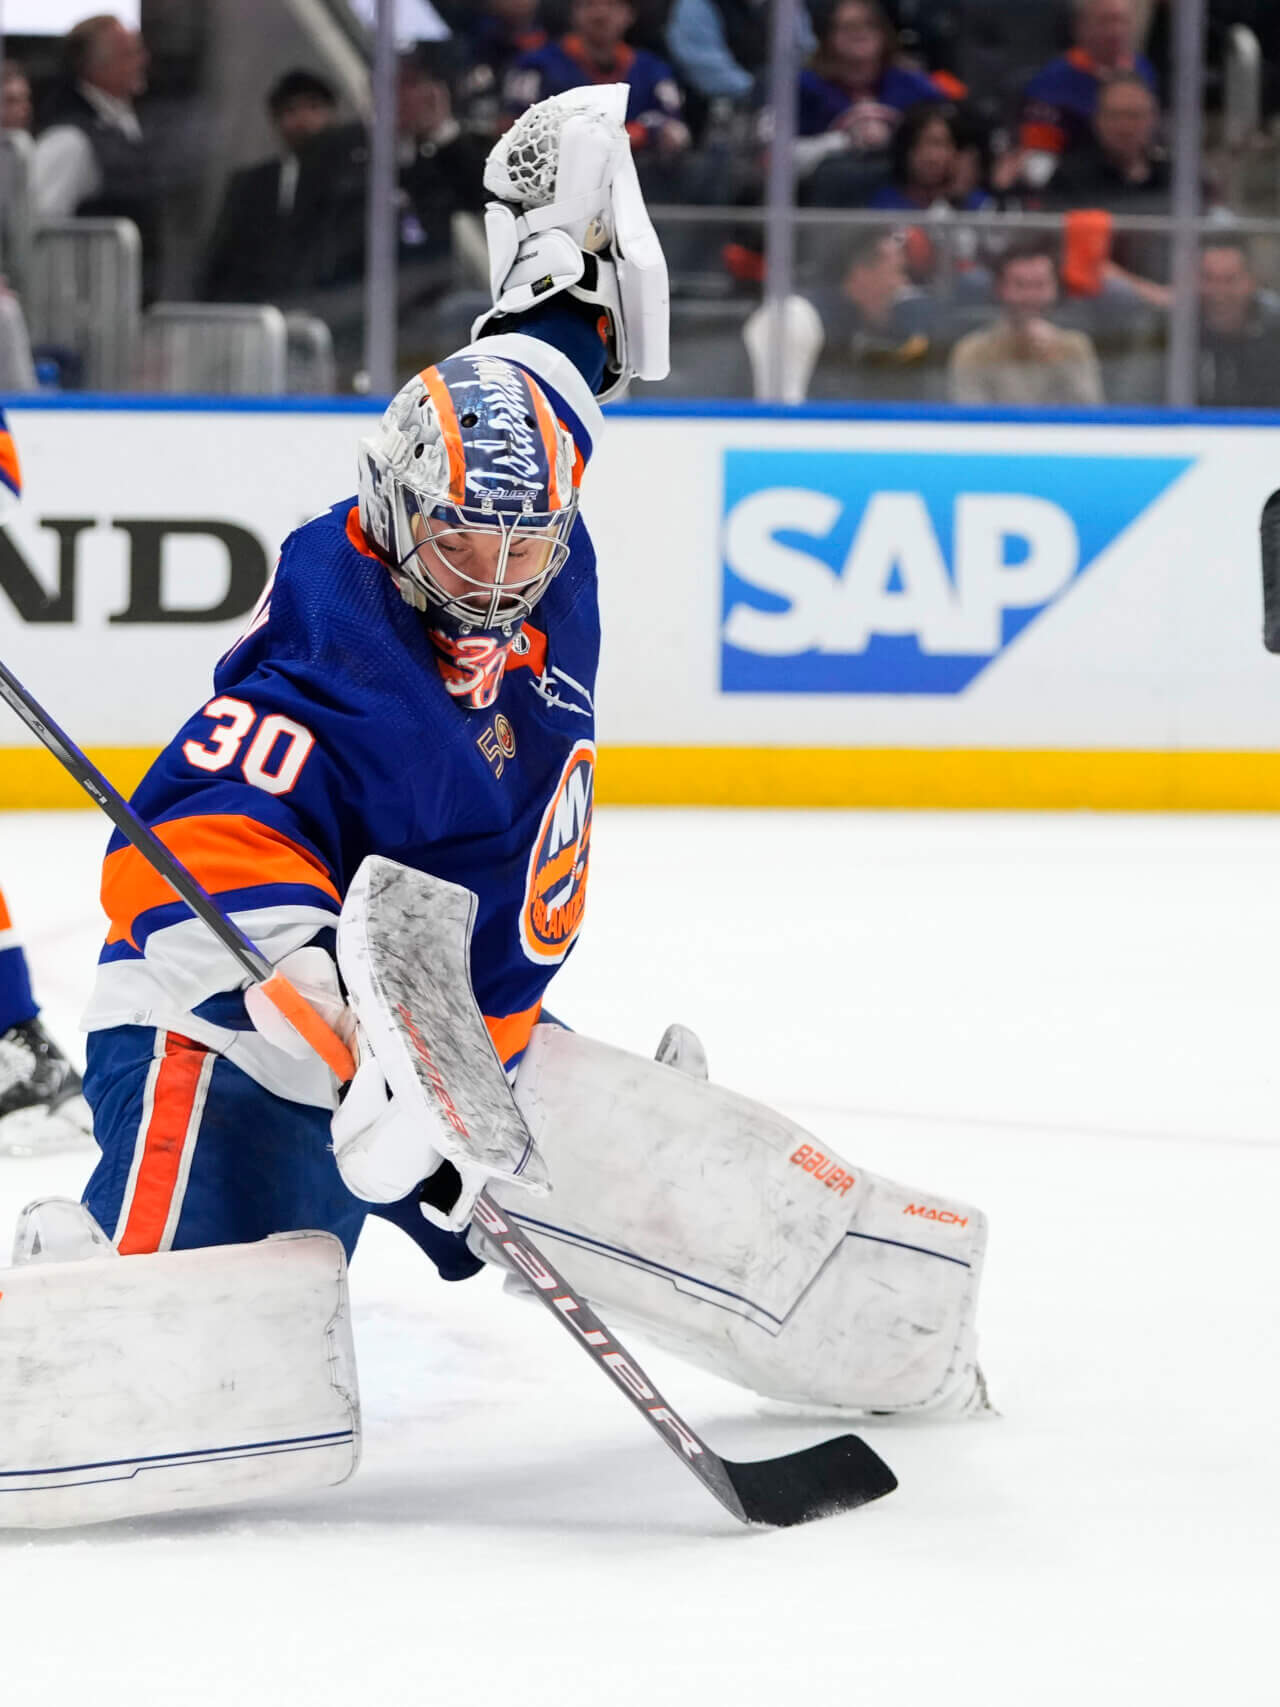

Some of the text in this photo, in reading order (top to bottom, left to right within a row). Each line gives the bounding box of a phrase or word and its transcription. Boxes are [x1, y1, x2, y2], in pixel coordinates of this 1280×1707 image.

[723, 486, 1081, 657] SAP
[181, 695, 317, 796] 30
[476, 712, 516, 780] 50
[903, 1202, 968, 1228] MACH
